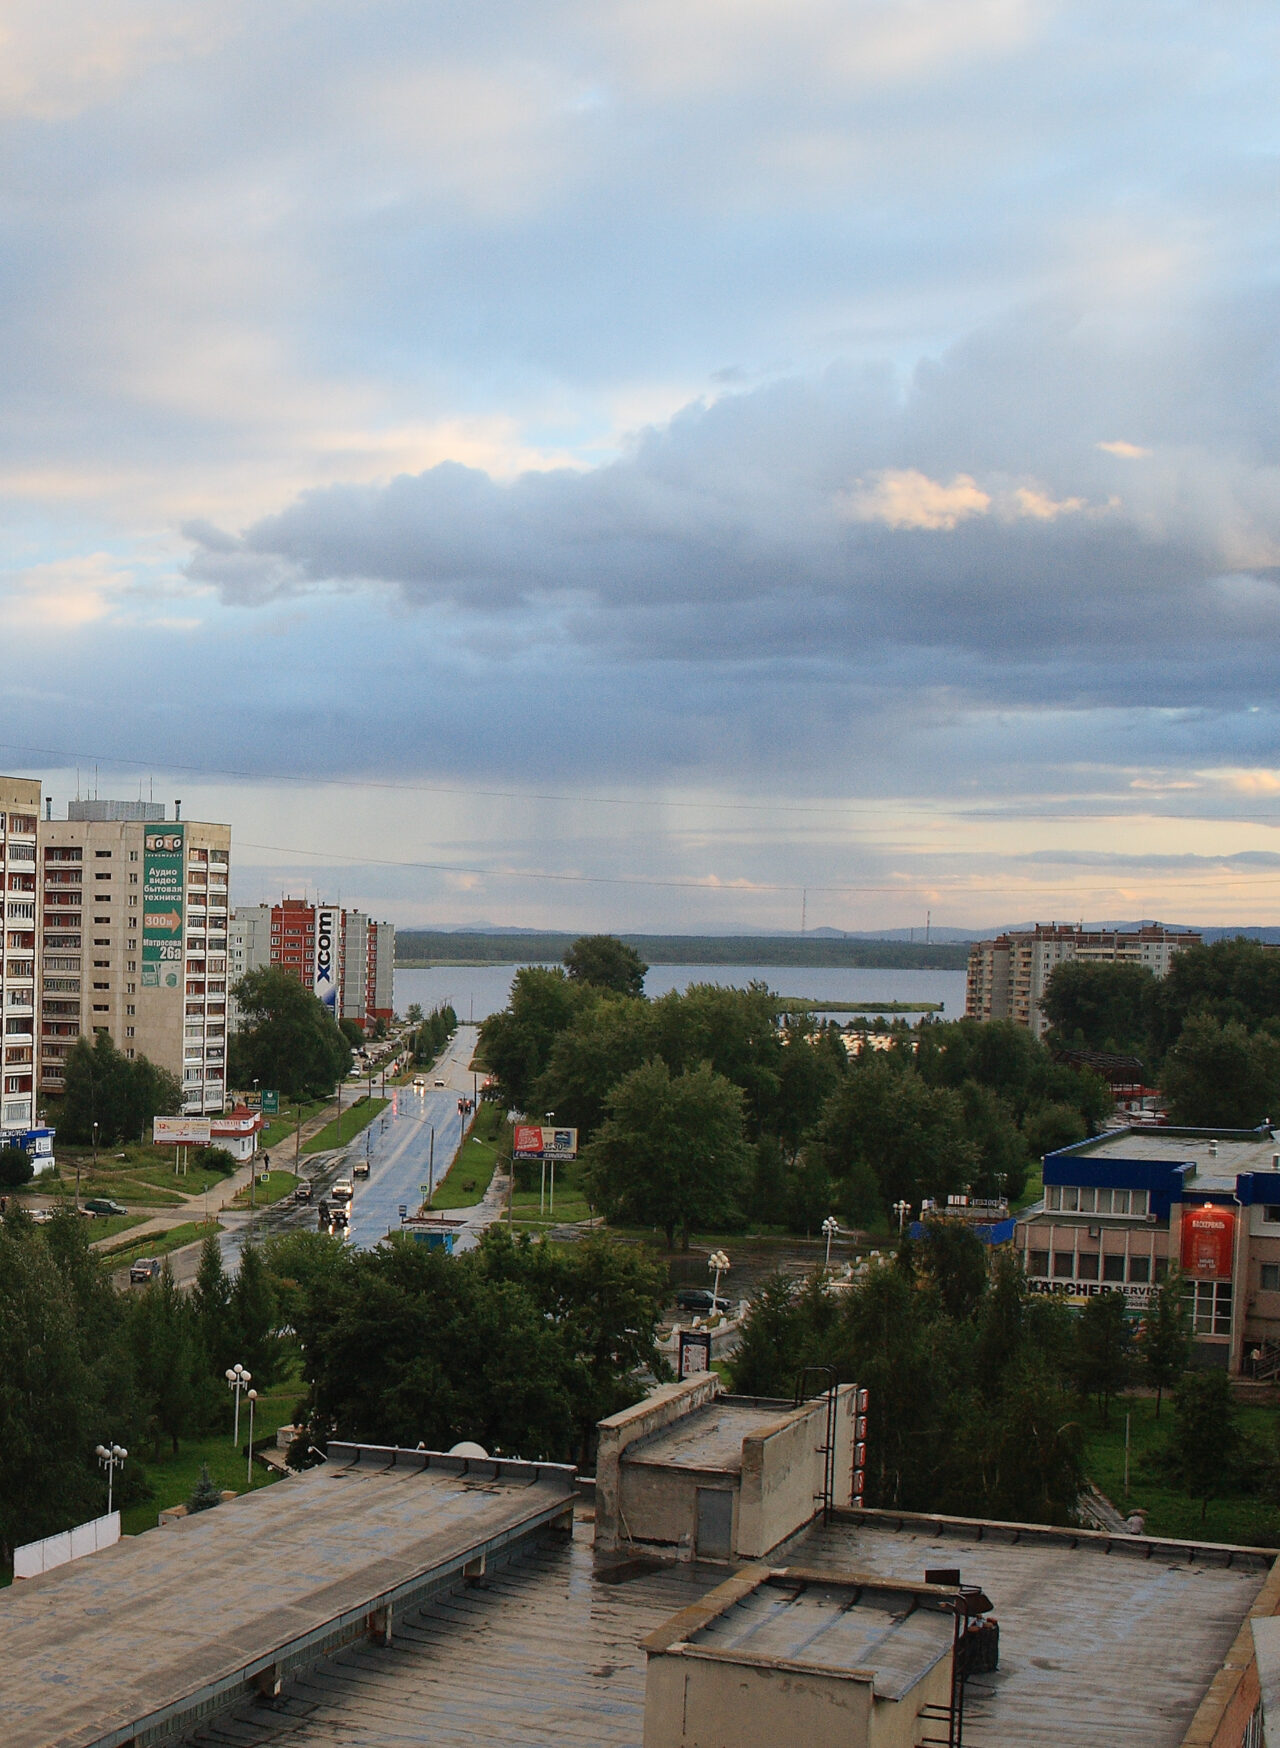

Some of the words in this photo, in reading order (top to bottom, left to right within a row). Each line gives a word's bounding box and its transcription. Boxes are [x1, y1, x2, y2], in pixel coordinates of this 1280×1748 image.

[149, 867, 177, 877] Аудио
[144, 885, 183, 893] бытовая
[143, 939, 182, 947] Матросова
[317, 912, 332, 983] xcom
